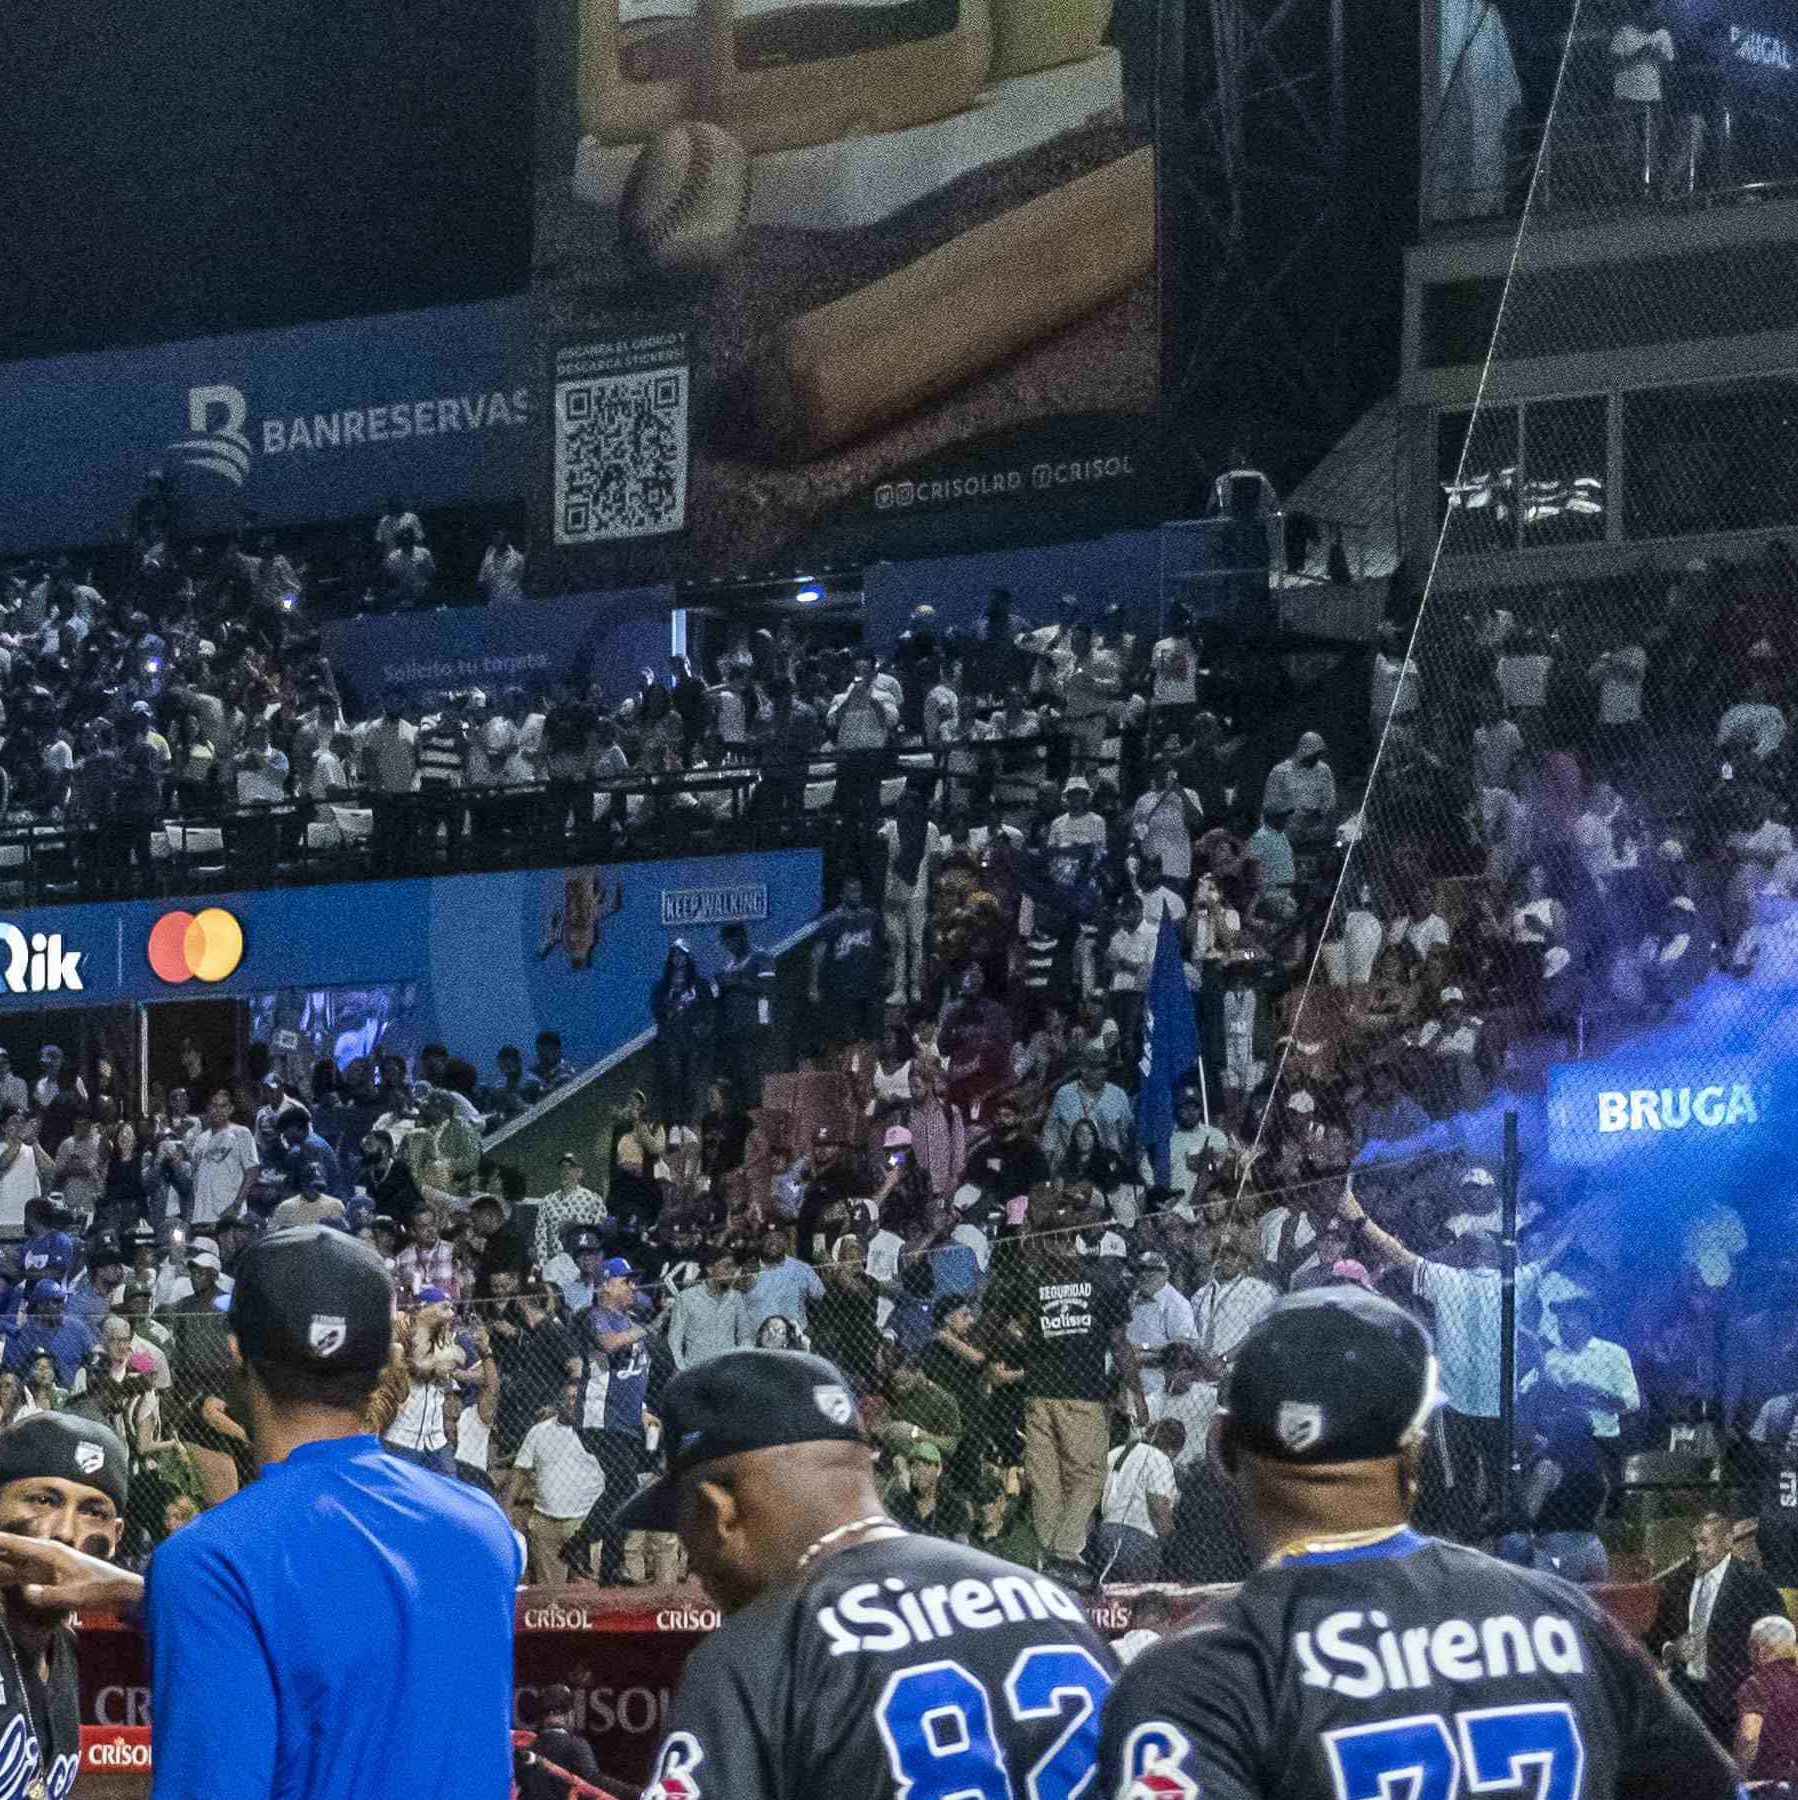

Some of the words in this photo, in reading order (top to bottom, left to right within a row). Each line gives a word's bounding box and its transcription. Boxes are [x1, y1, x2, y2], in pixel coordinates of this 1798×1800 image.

[262, 387, 529, 456] BANRESERVAS
[1598, 1084, 1758, 1132] BRUGA
[524, 1609, 592, 1629] CRISOL
[836, 1577, 1087, 1652] Sirena
[1315, 1610, 1584, 1698] Sirena
